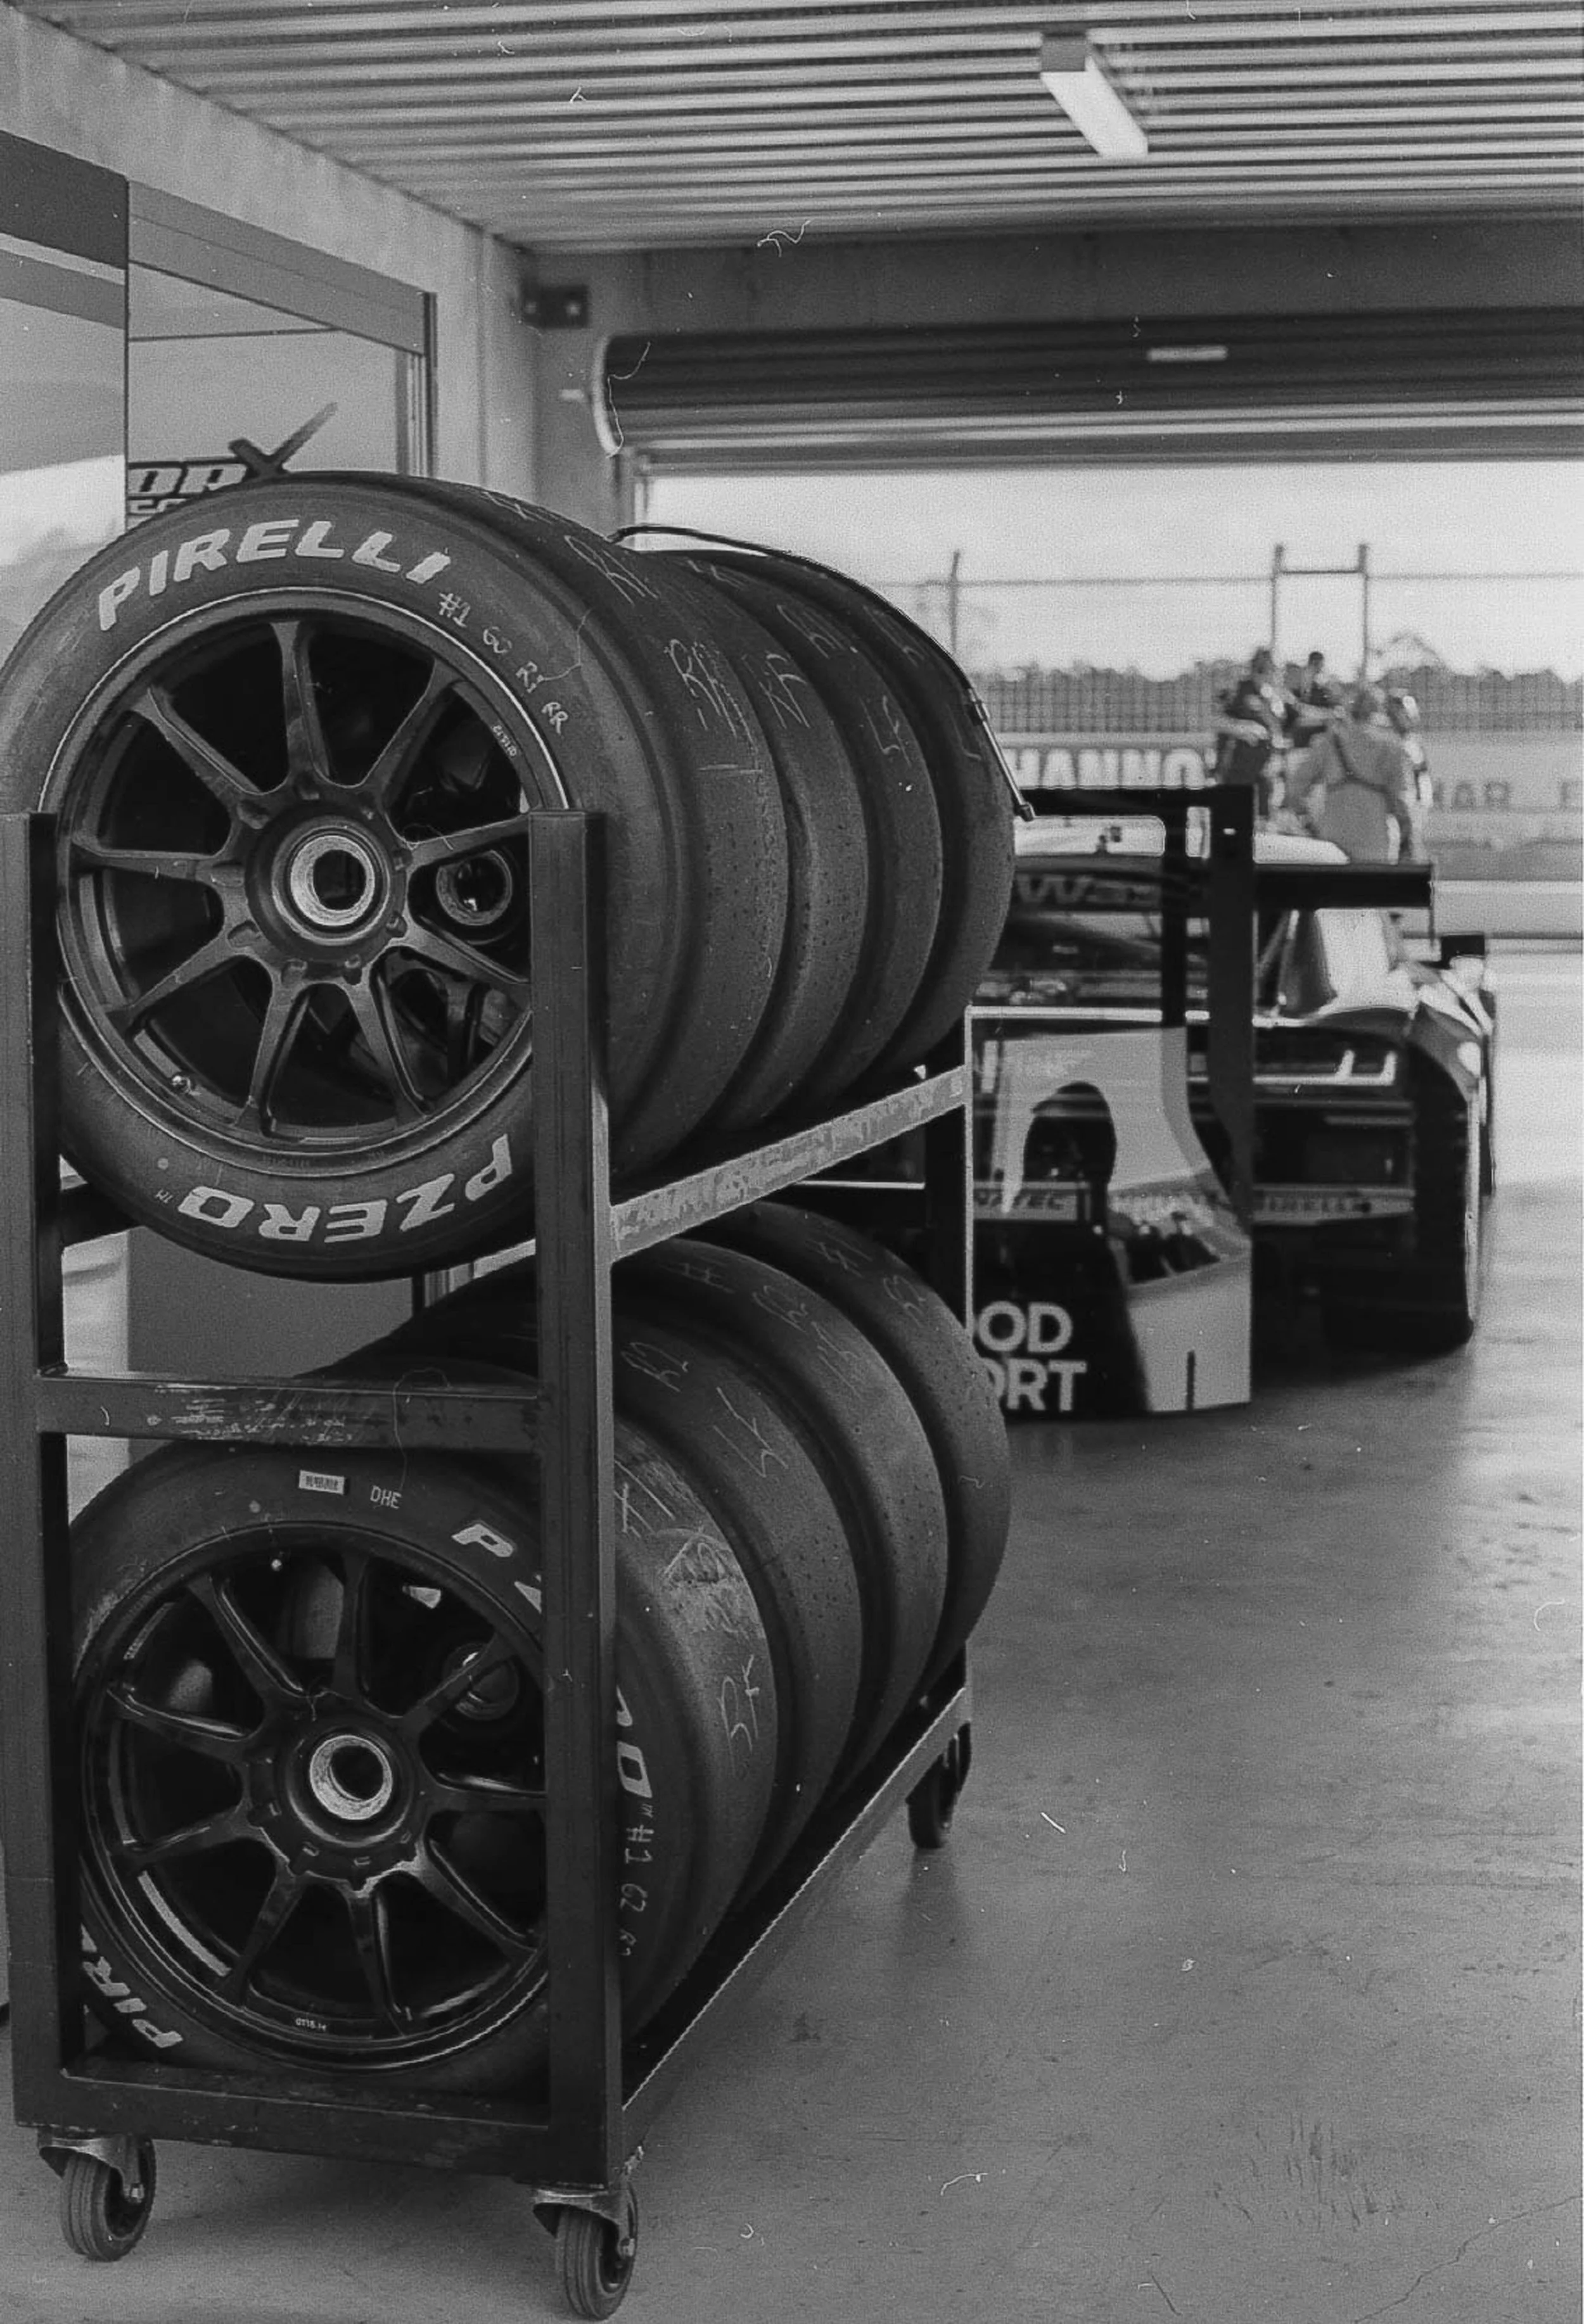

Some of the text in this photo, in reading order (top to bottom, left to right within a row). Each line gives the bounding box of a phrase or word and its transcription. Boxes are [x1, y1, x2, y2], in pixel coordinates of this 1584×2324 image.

[98, 519, 450, 631] PIRELLI
[438, 592, 471, 628] #1
[541, 701, 569, 734] RR
[80, 1921, 184, 2048] PIR
